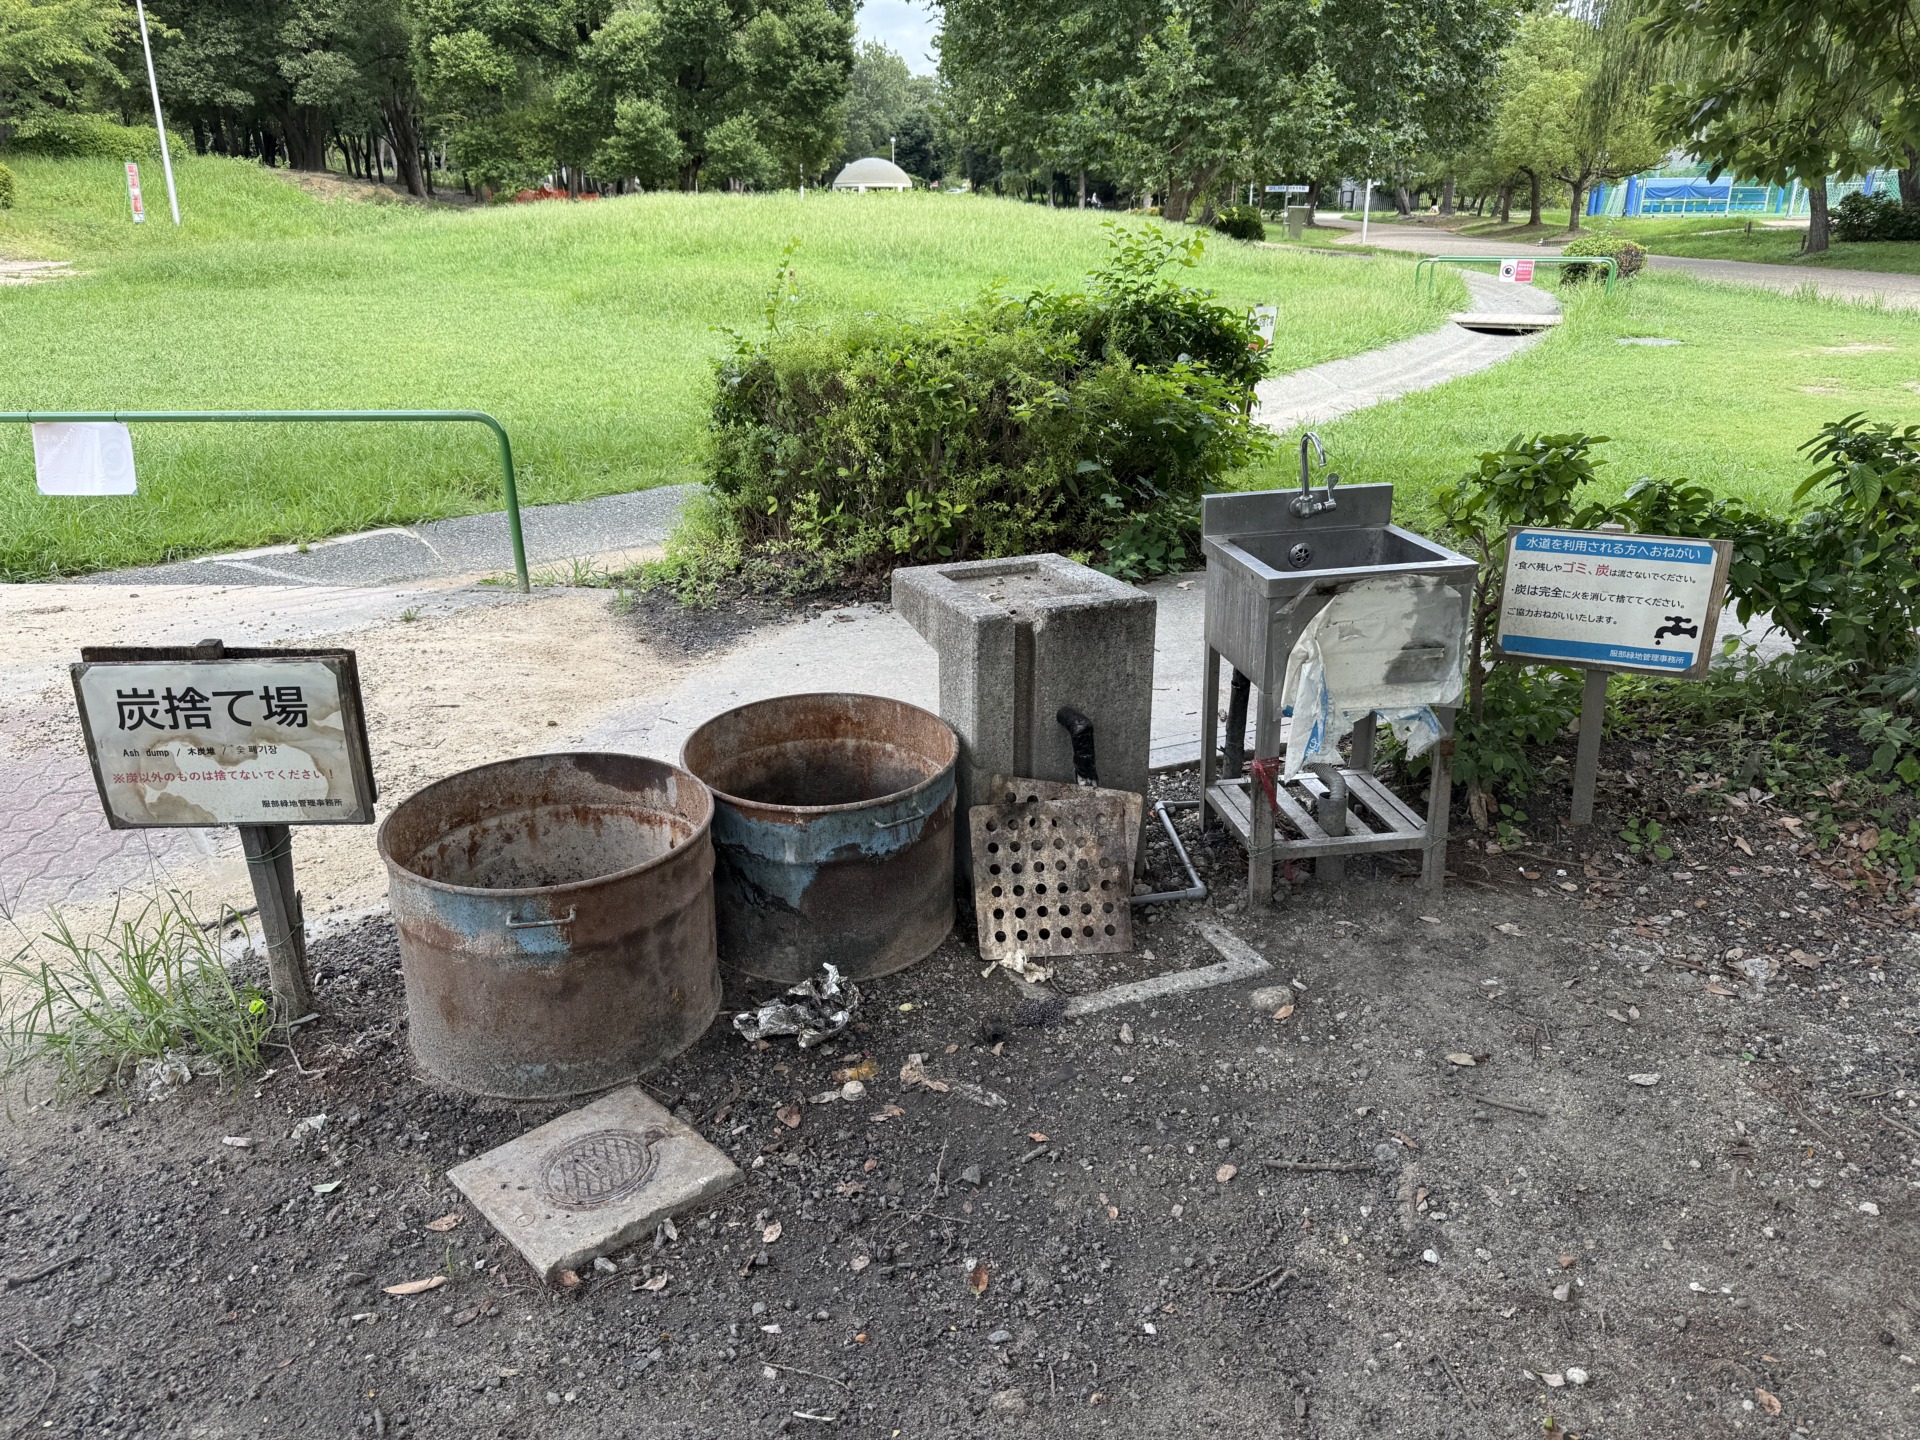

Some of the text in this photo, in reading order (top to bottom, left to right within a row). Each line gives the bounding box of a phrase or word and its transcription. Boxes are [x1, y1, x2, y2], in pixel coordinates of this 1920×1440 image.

[1526, 536, 1701, 560] 水道を利用される方へおねがい
[1506, 606, 1618, 625] ご協力おねがいいたします。
[116, 685, 309, 732] 炭捨て場
[123, 748, 140, 758] Ash
[145, 748, 170, 758] dump
